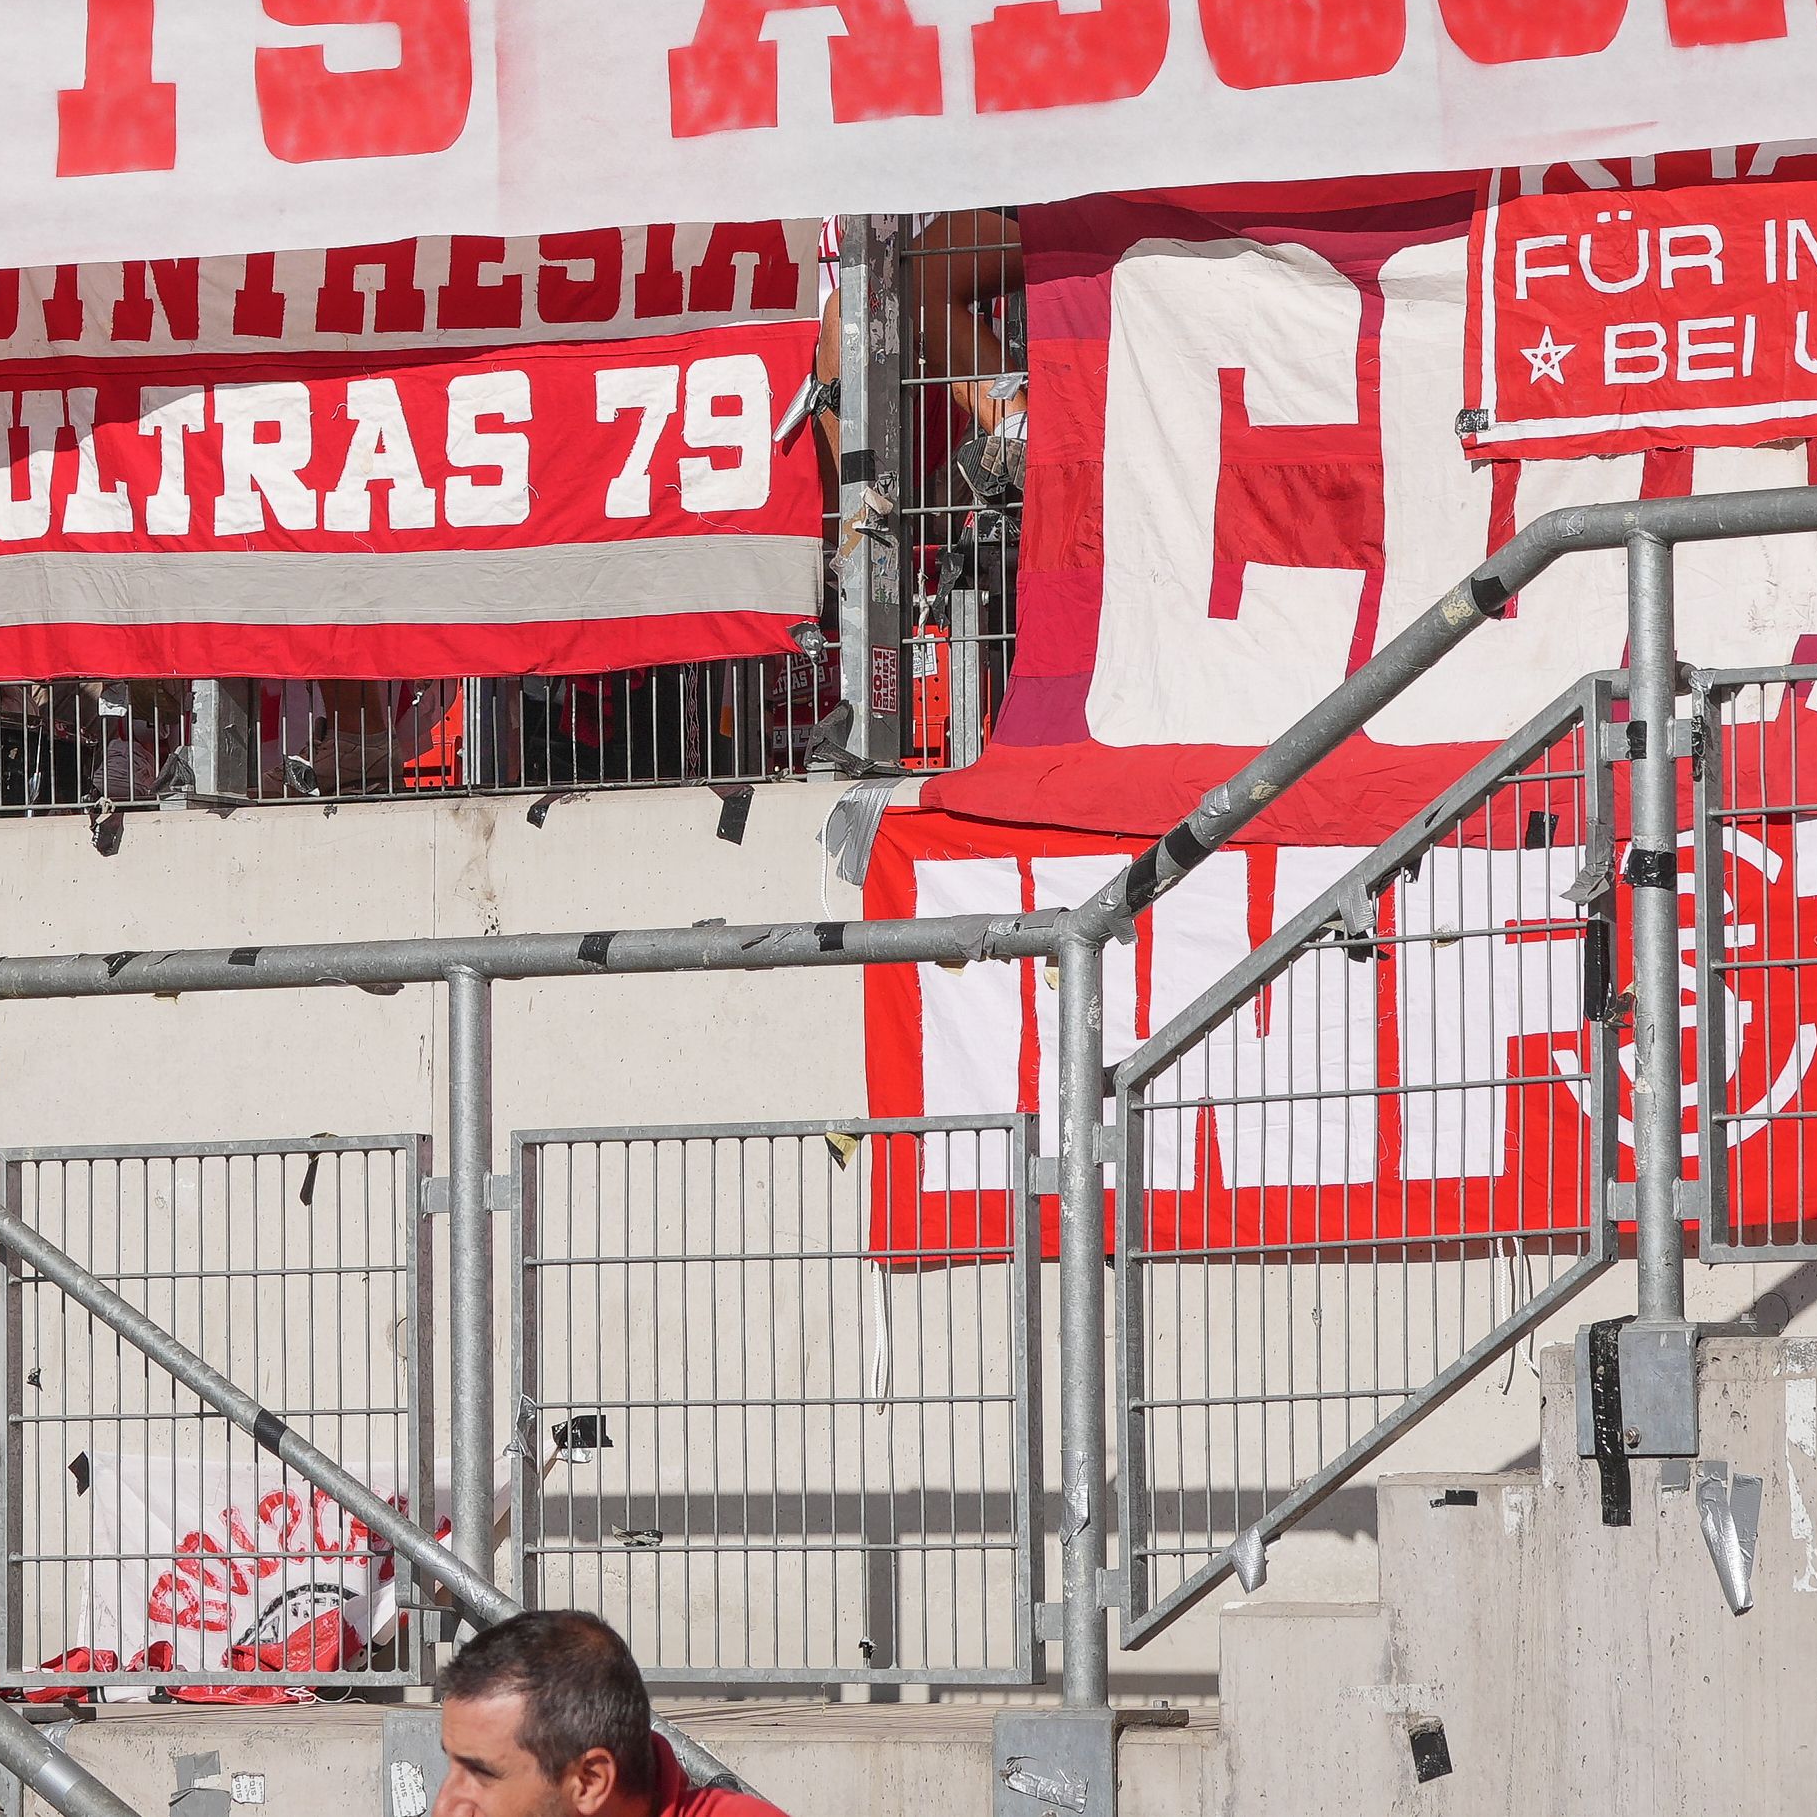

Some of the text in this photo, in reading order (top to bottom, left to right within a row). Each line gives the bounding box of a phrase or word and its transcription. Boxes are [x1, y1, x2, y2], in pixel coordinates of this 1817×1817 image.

[1514, 209, 1727, 301] FÜR
[1600, 320, 1758, 388] BEI
[594, 353, 773, 519] 79
